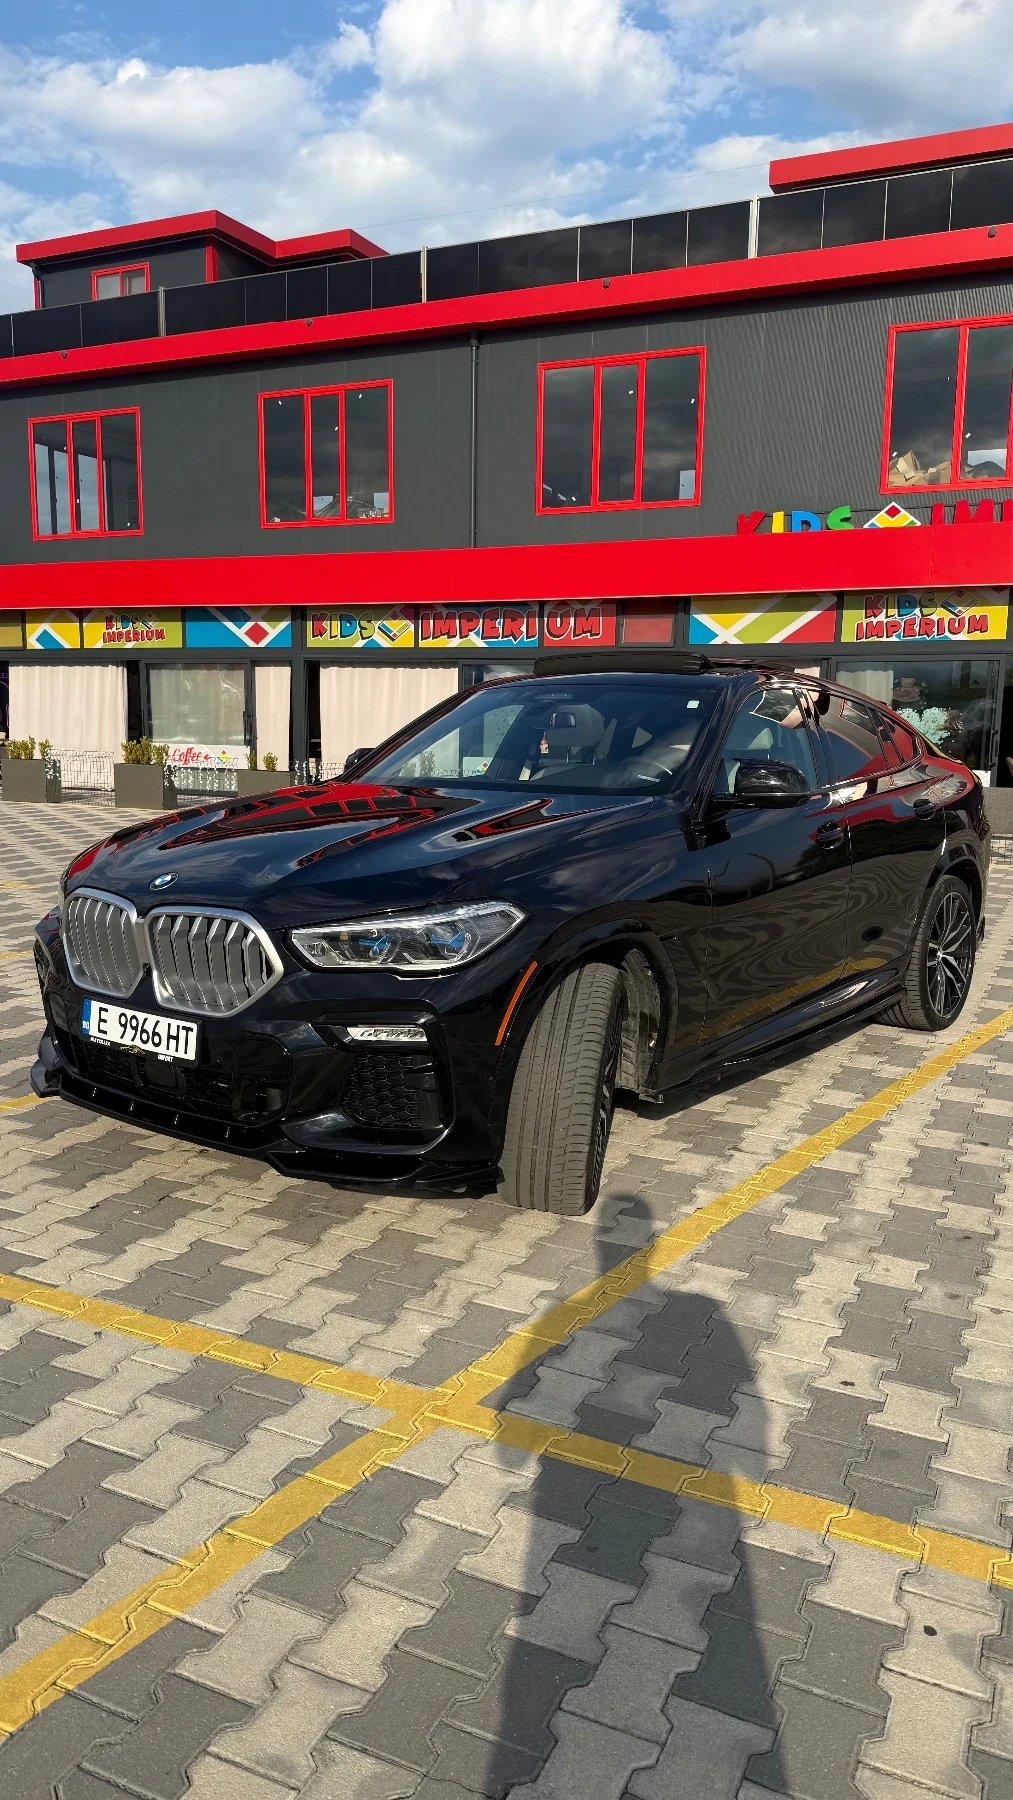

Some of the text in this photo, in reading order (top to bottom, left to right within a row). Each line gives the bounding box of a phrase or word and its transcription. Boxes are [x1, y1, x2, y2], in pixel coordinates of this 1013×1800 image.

[864, 591, 937, 618] KIDS
[105, 613, 141, 631] KIDS
[310, 606, 603, 643] KIDS IMPERIUM
[855, 614, 989, 641] IMPERIUM
[102, 628, 166, 644] IMPERIUM
[97, 1007, 194, 1054] E 9966 HT
